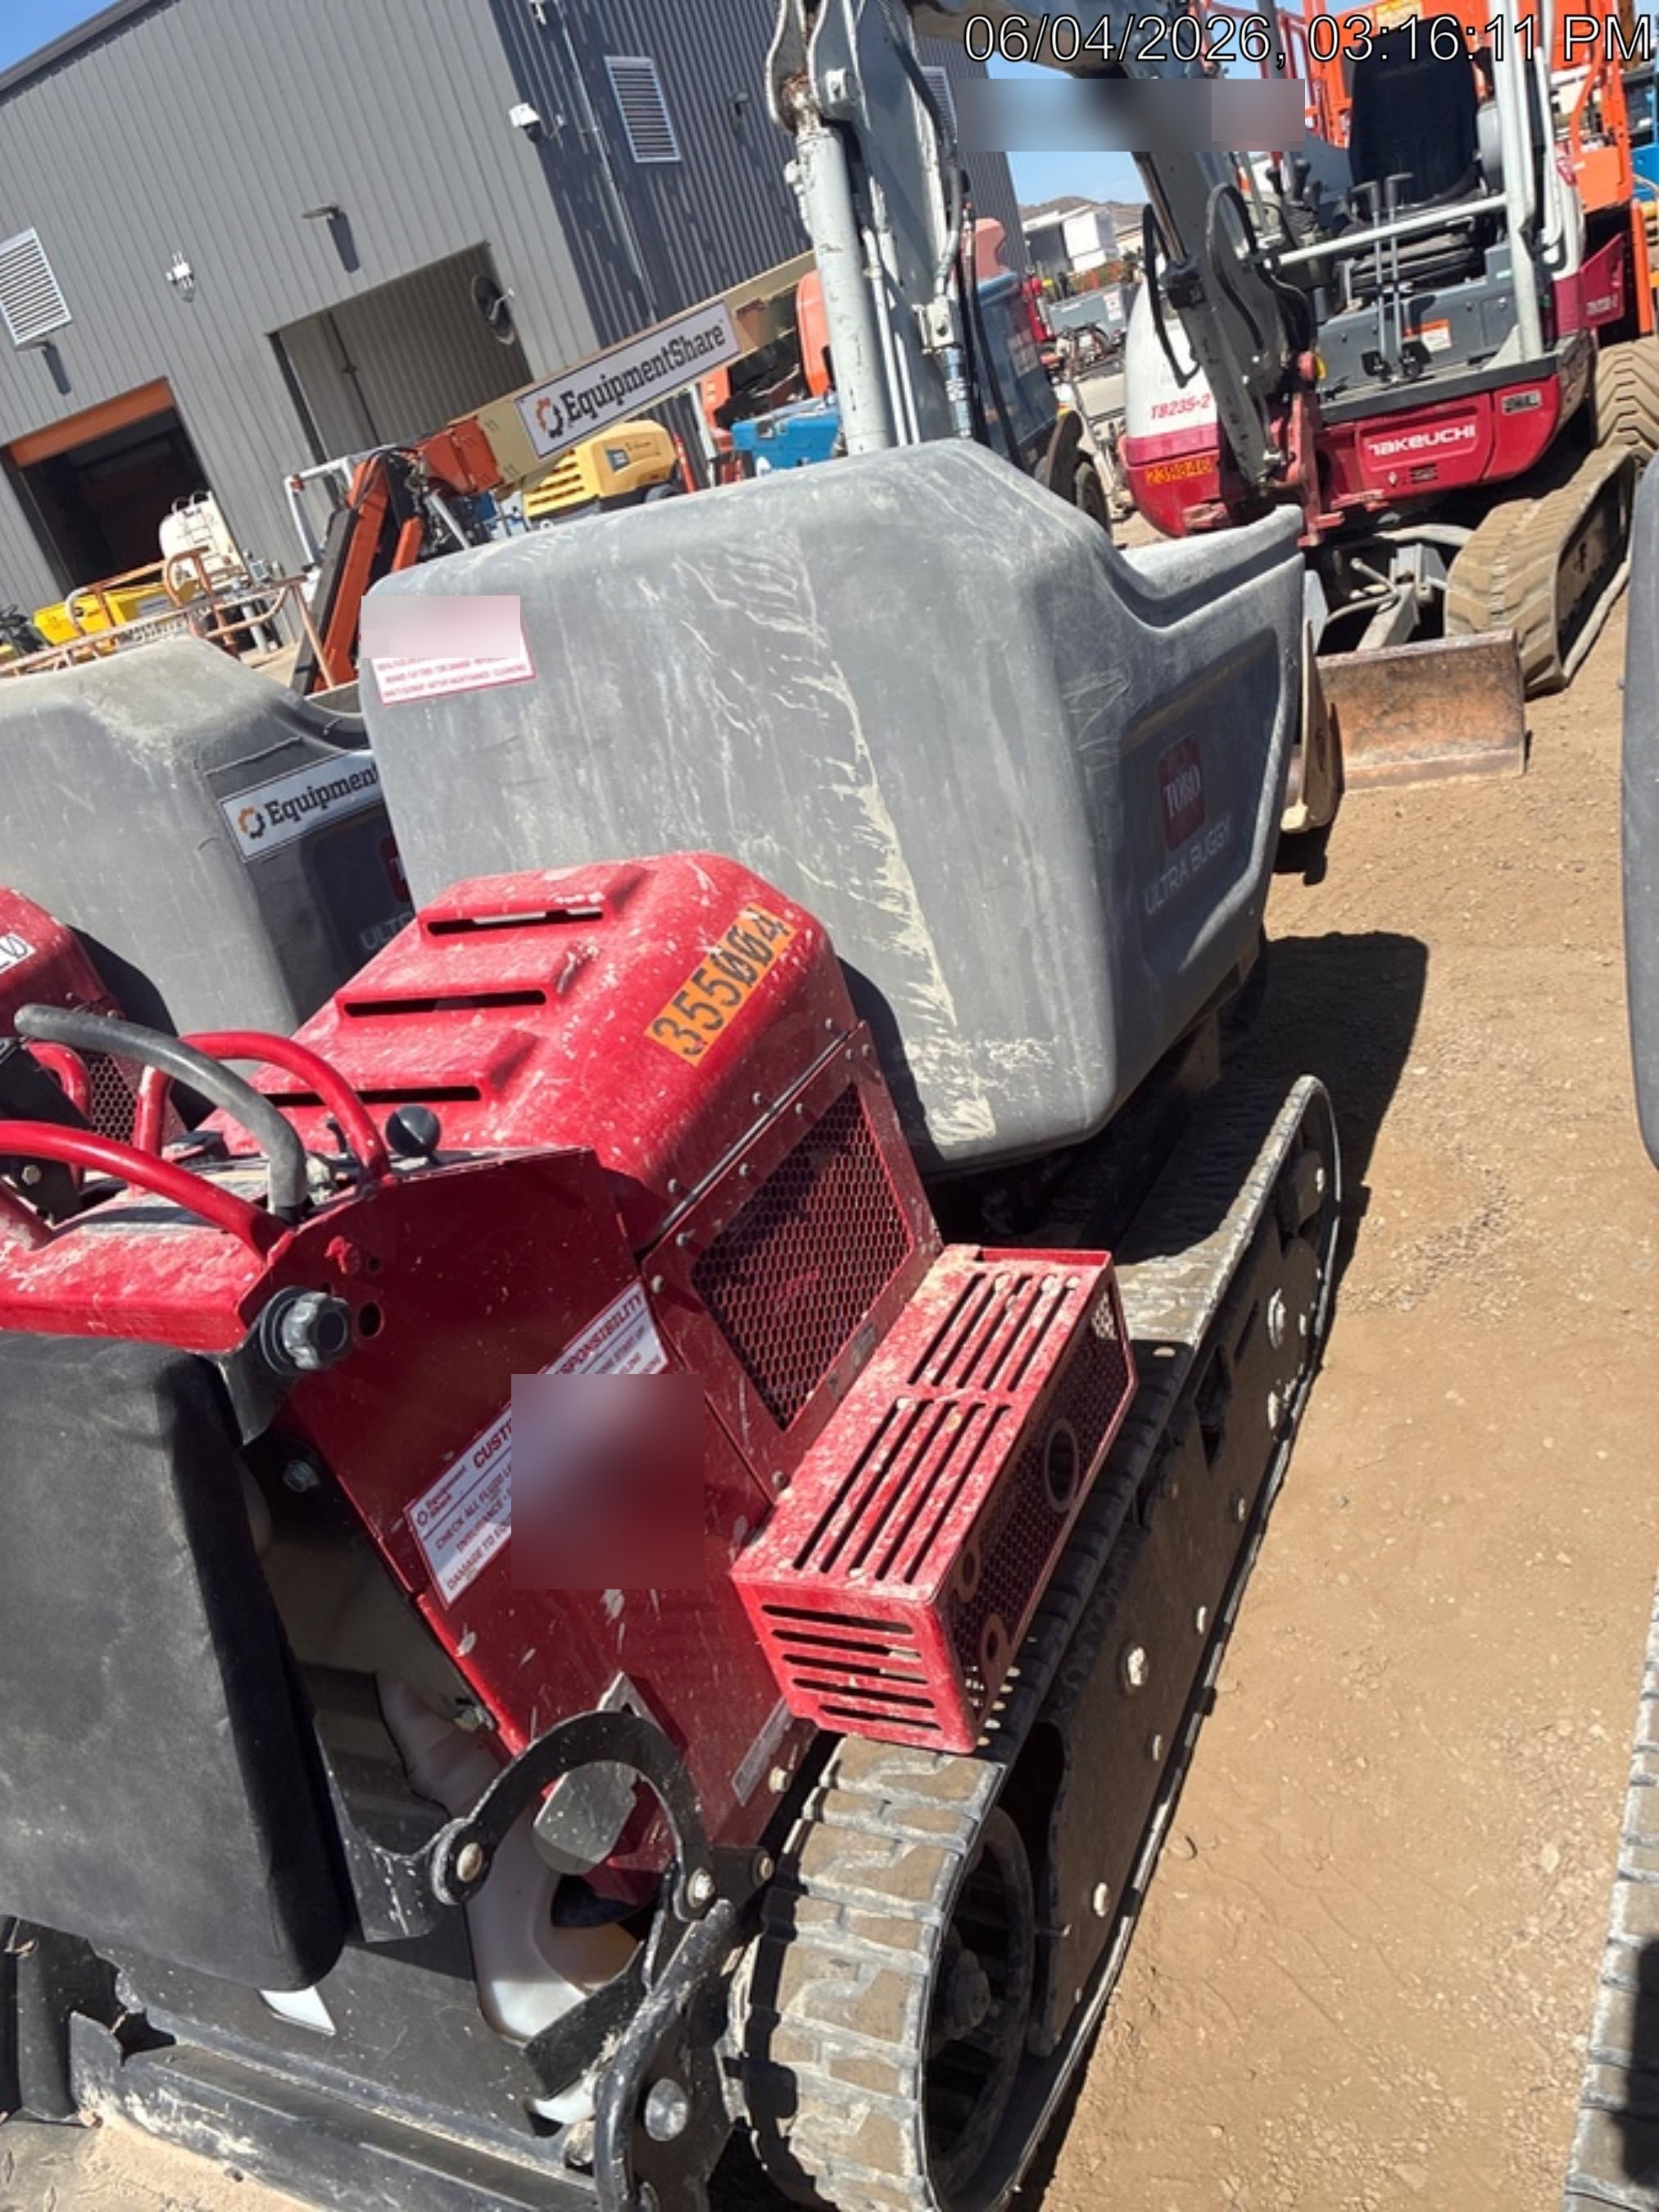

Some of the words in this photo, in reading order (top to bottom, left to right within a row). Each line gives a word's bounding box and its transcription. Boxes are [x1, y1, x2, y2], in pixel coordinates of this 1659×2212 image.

[559, 325, 726, 424] EquipmentShare
[1163, 762, 1202, 820] TORO
[1143, 857, 1189, 917] ULTRA
[651, 906, 791, 1057] 355004
[465, 1500, 479, 1516] ALL
